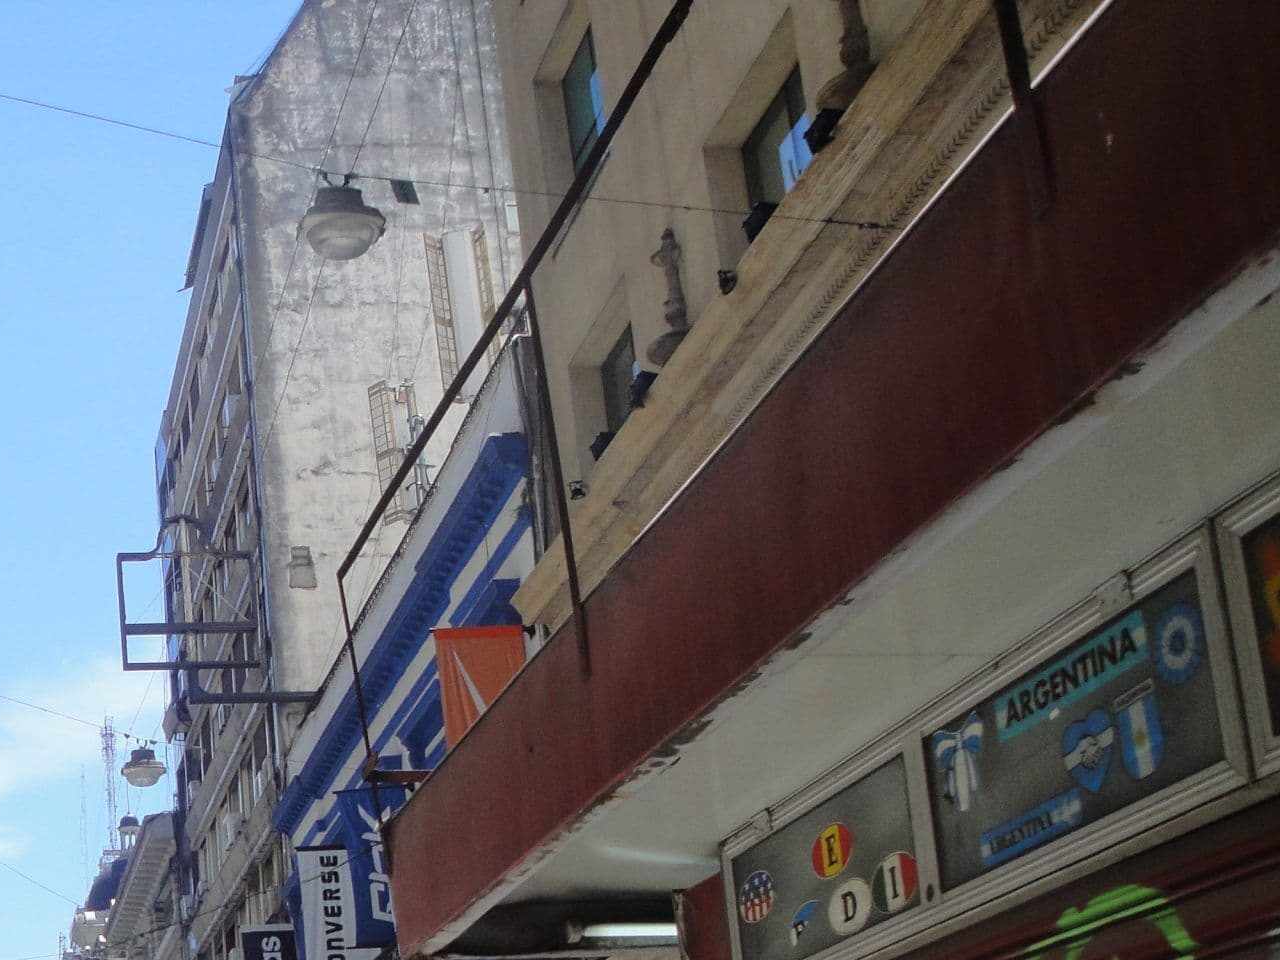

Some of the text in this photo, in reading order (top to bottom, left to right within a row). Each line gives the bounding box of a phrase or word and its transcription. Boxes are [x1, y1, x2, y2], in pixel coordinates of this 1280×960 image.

[1005, 626, 1138, 729] ARGENTINA
[824, 834, 838, 867] E
[888, 866, 900, 900] I
[840, 891, 857, 923] D
